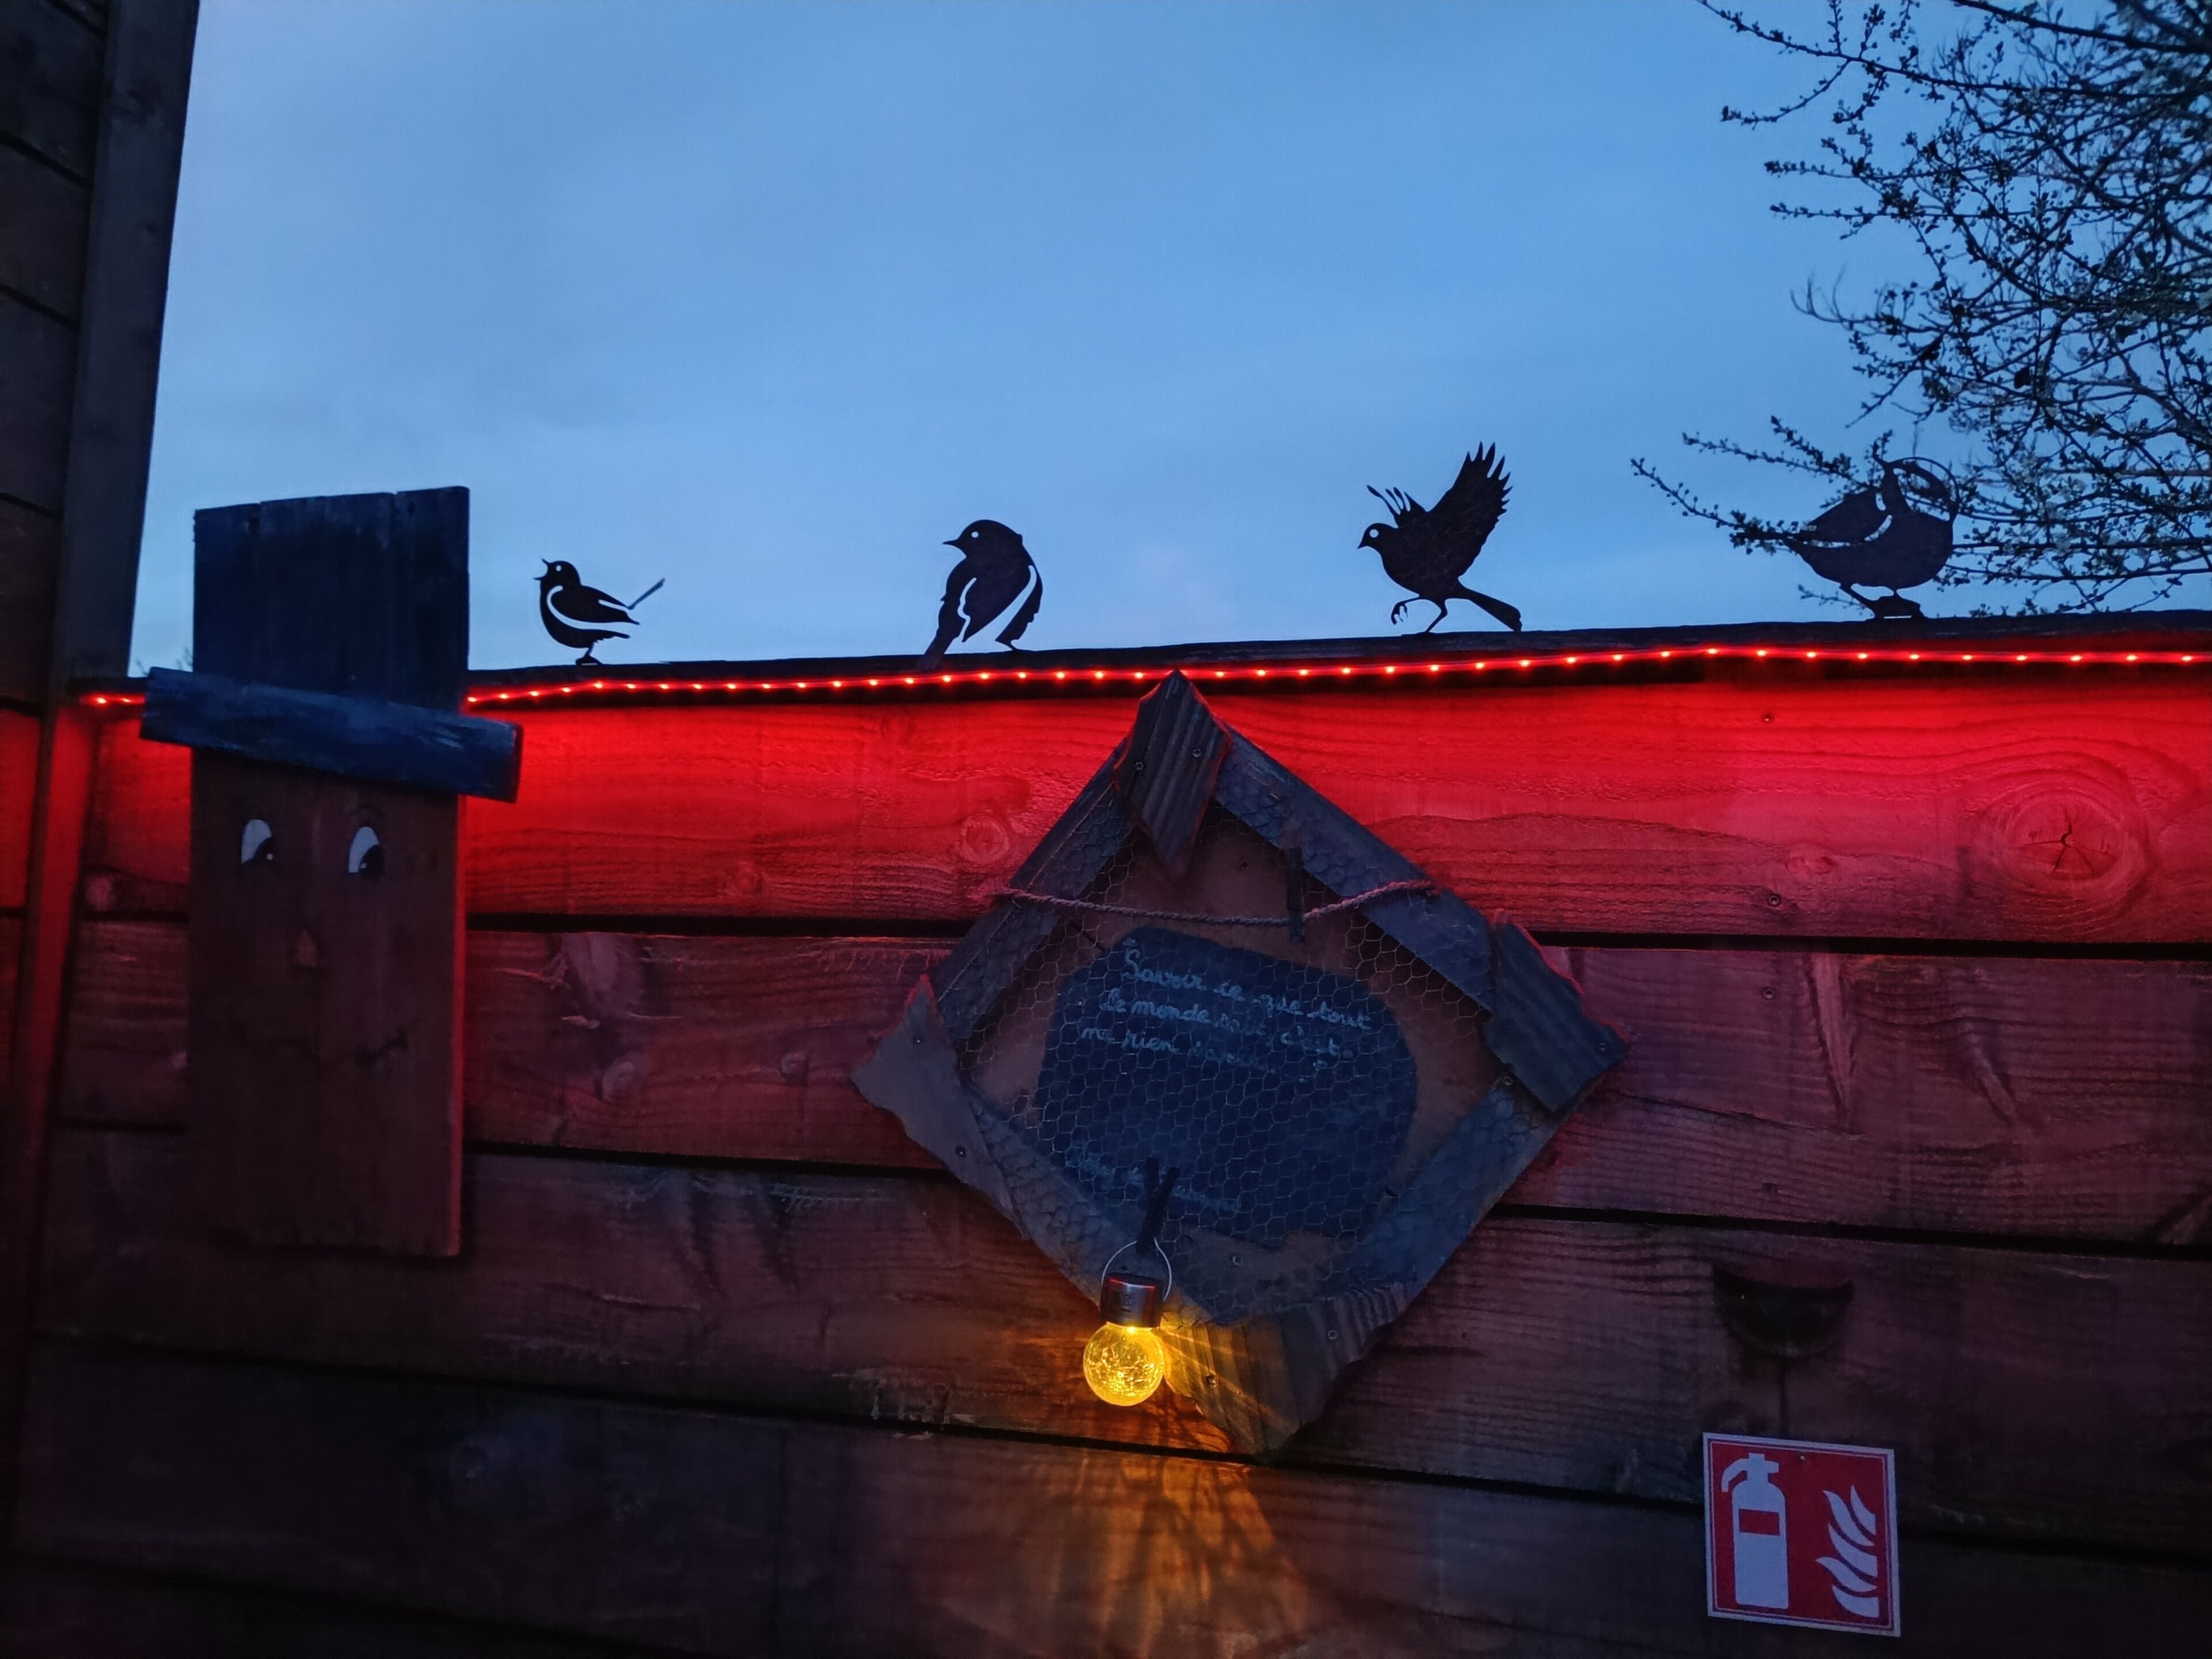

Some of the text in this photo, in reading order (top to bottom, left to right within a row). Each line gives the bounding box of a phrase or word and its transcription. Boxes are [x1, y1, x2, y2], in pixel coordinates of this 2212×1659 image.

[1131, 1003, 1211, 1024] monde
[1213, 981, 1246, 1001] ce
[1253, 994, 1304, 1018] que
[1306, 1001, 1372, 1030] tout
[1121, 1029, 1180, 1052] rien
